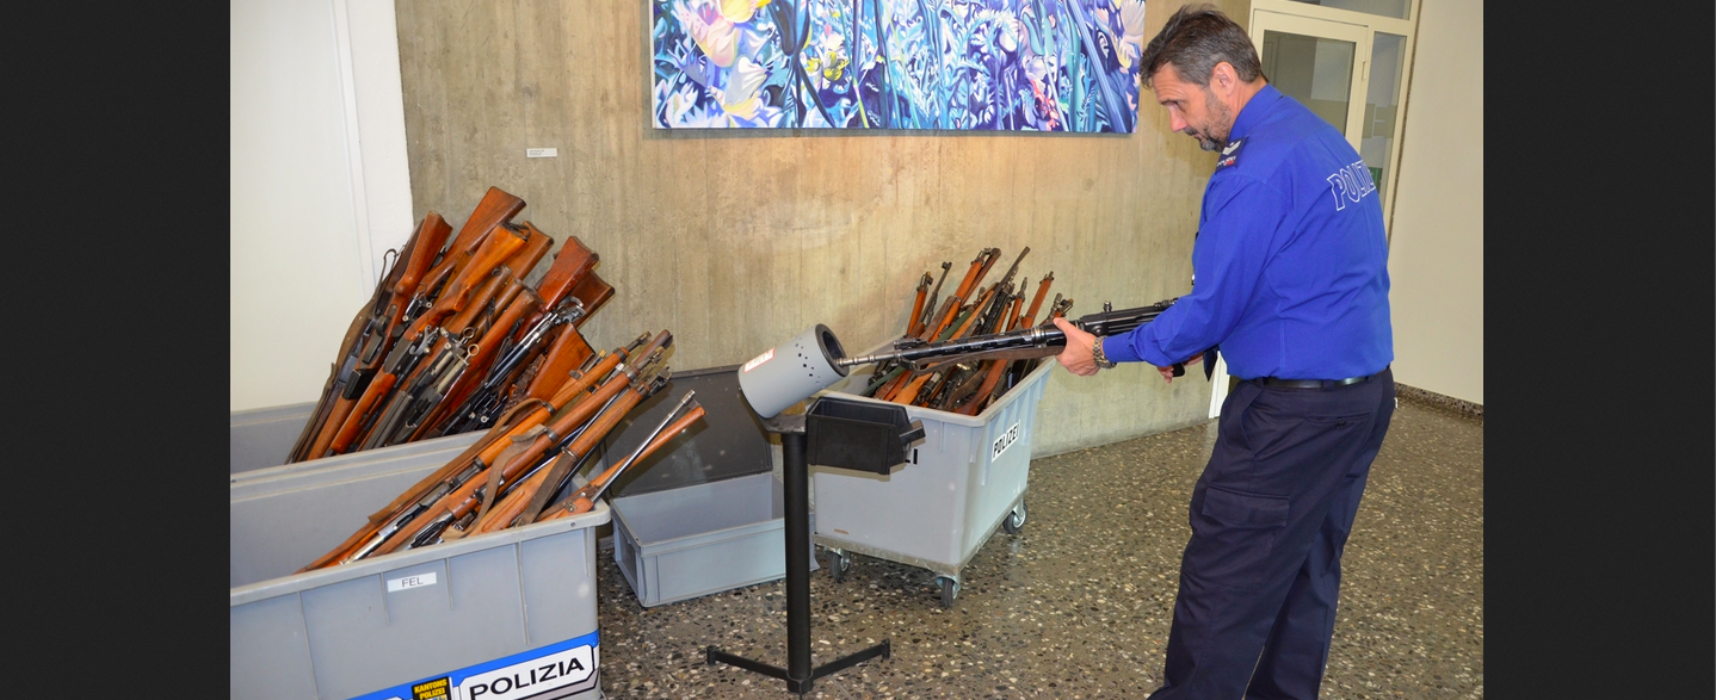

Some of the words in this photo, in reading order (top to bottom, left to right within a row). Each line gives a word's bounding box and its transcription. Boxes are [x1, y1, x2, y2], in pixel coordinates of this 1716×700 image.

[993, 423, 1019, 458] POLIZEI
[401, 576, 424, 588] FEL
[413, 678, 447, 694] KANTONS
[469, 657, 585, 700] POLIZIA
[419, 687, 446, 700] POLIZEI
